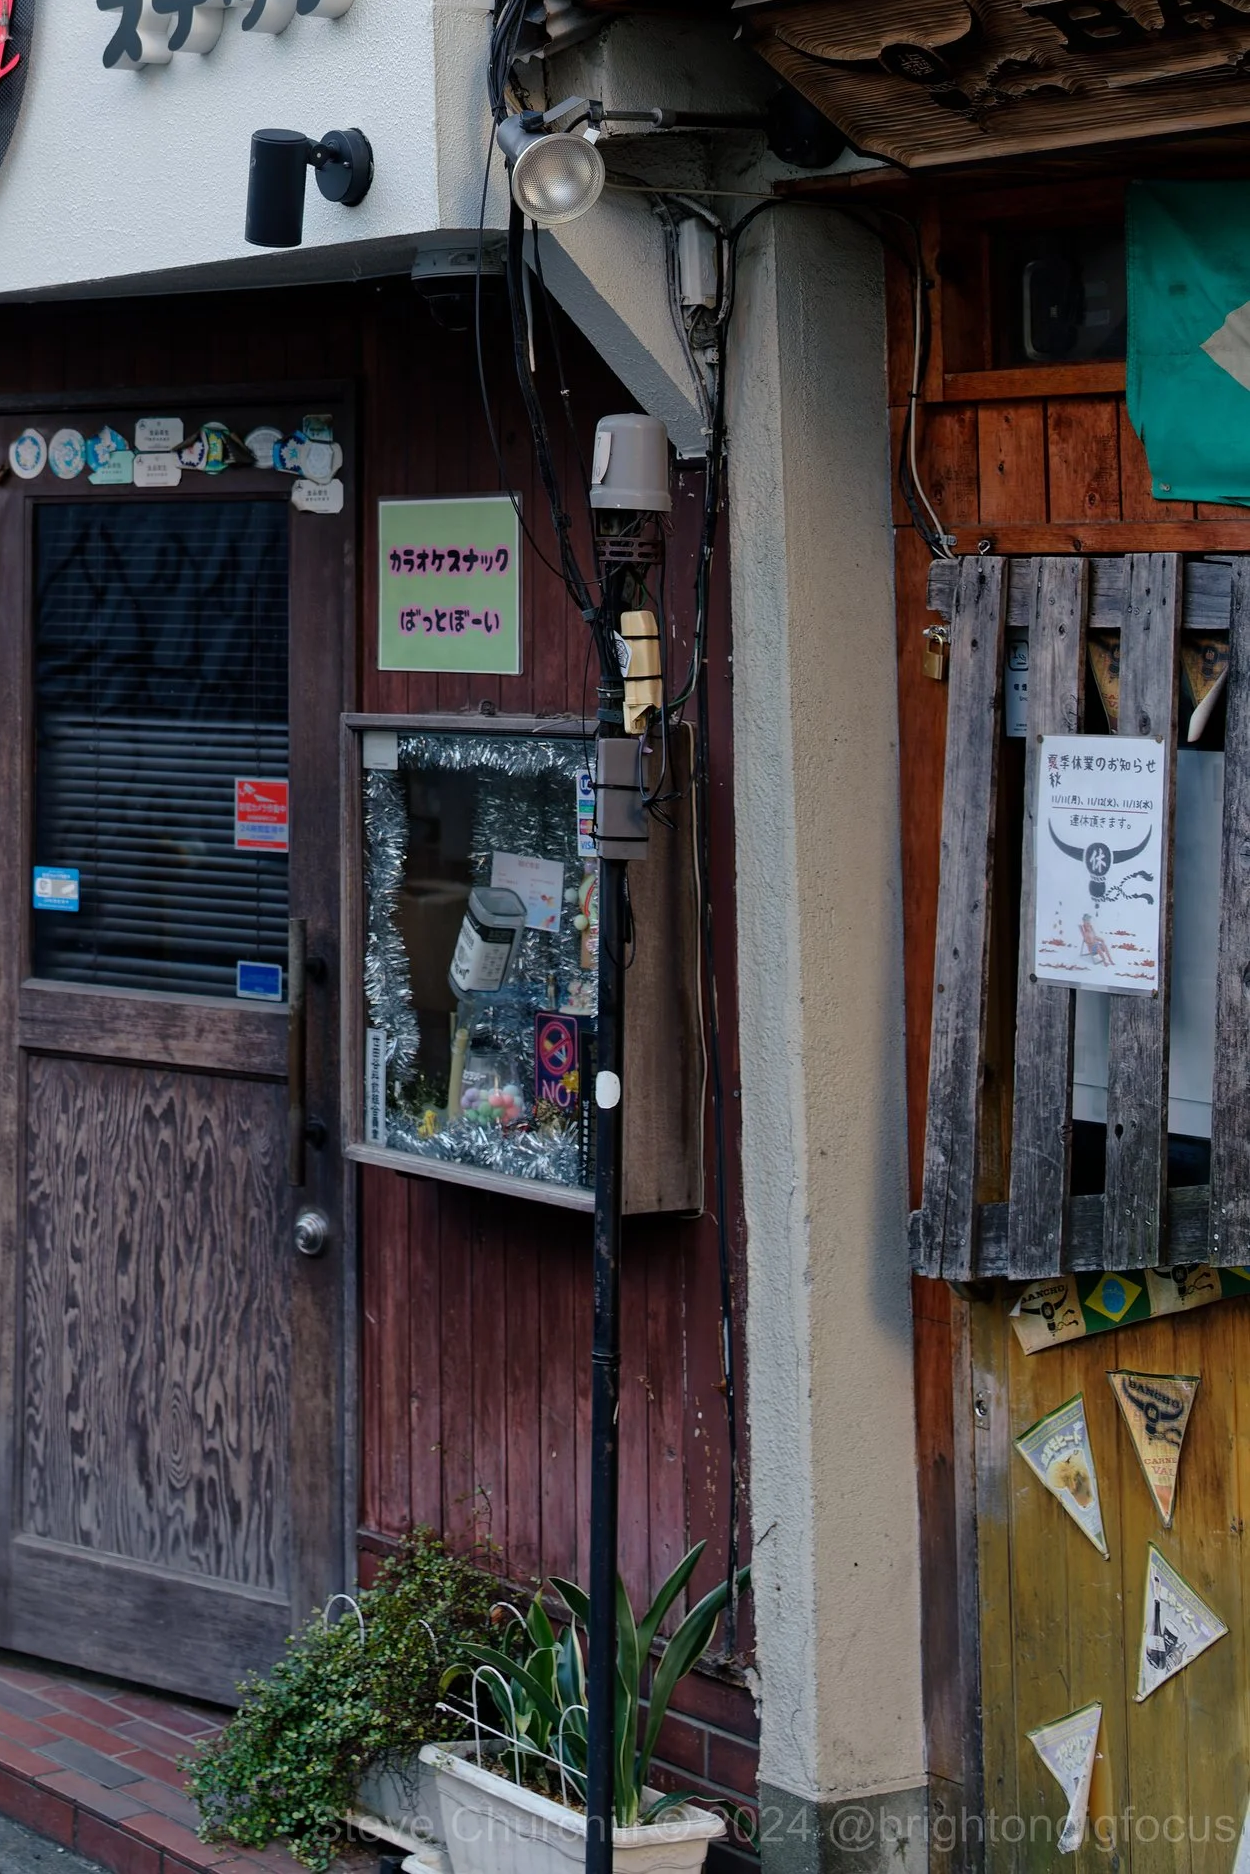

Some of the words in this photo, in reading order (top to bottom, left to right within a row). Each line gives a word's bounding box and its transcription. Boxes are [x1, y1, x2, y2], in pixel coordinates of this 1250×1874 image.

[389, 548, 509, 573] カラオケスナック
[400, 608, 500, 633] ばっとぼーい
[1047, 753, 1157, 774] 夏季休業のお知らせ
[1049, 773, 1062, 788] 秋
[1069, 814, 1132, 830] 連休頂きます。
[1089, 848, 1107, 873] 休
